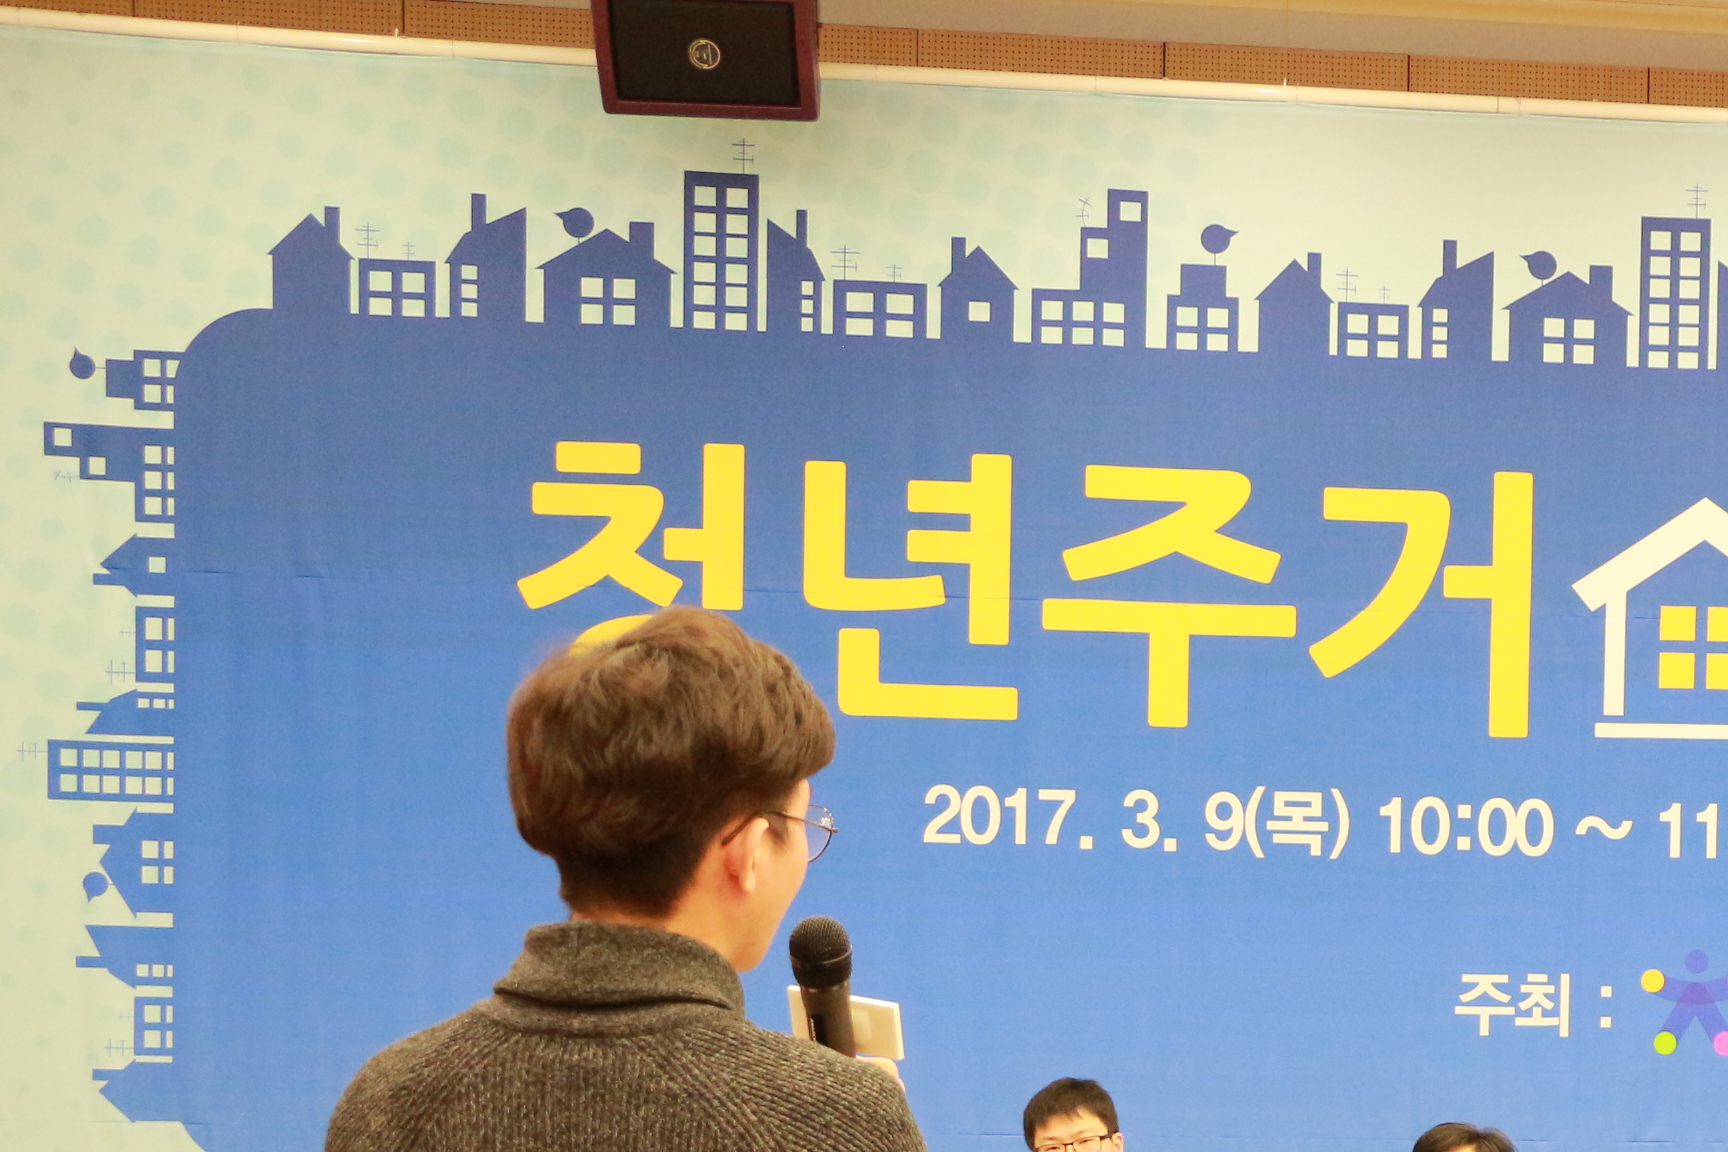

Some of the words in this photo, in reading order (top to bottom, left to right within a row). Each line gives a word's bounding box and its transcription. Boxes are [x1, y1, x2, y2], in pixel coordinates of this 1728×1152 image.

[516, 440, 1534, 738] 청년주거
[922, 783, 1093, 851] 2017.
[1121, 788, 1178, 853] 3.
[1203, 784, 1351, 860] 9(목)
[1378, 795, 1555, 857] 10:00
[1453, 972, 1571, 1038] 주최
